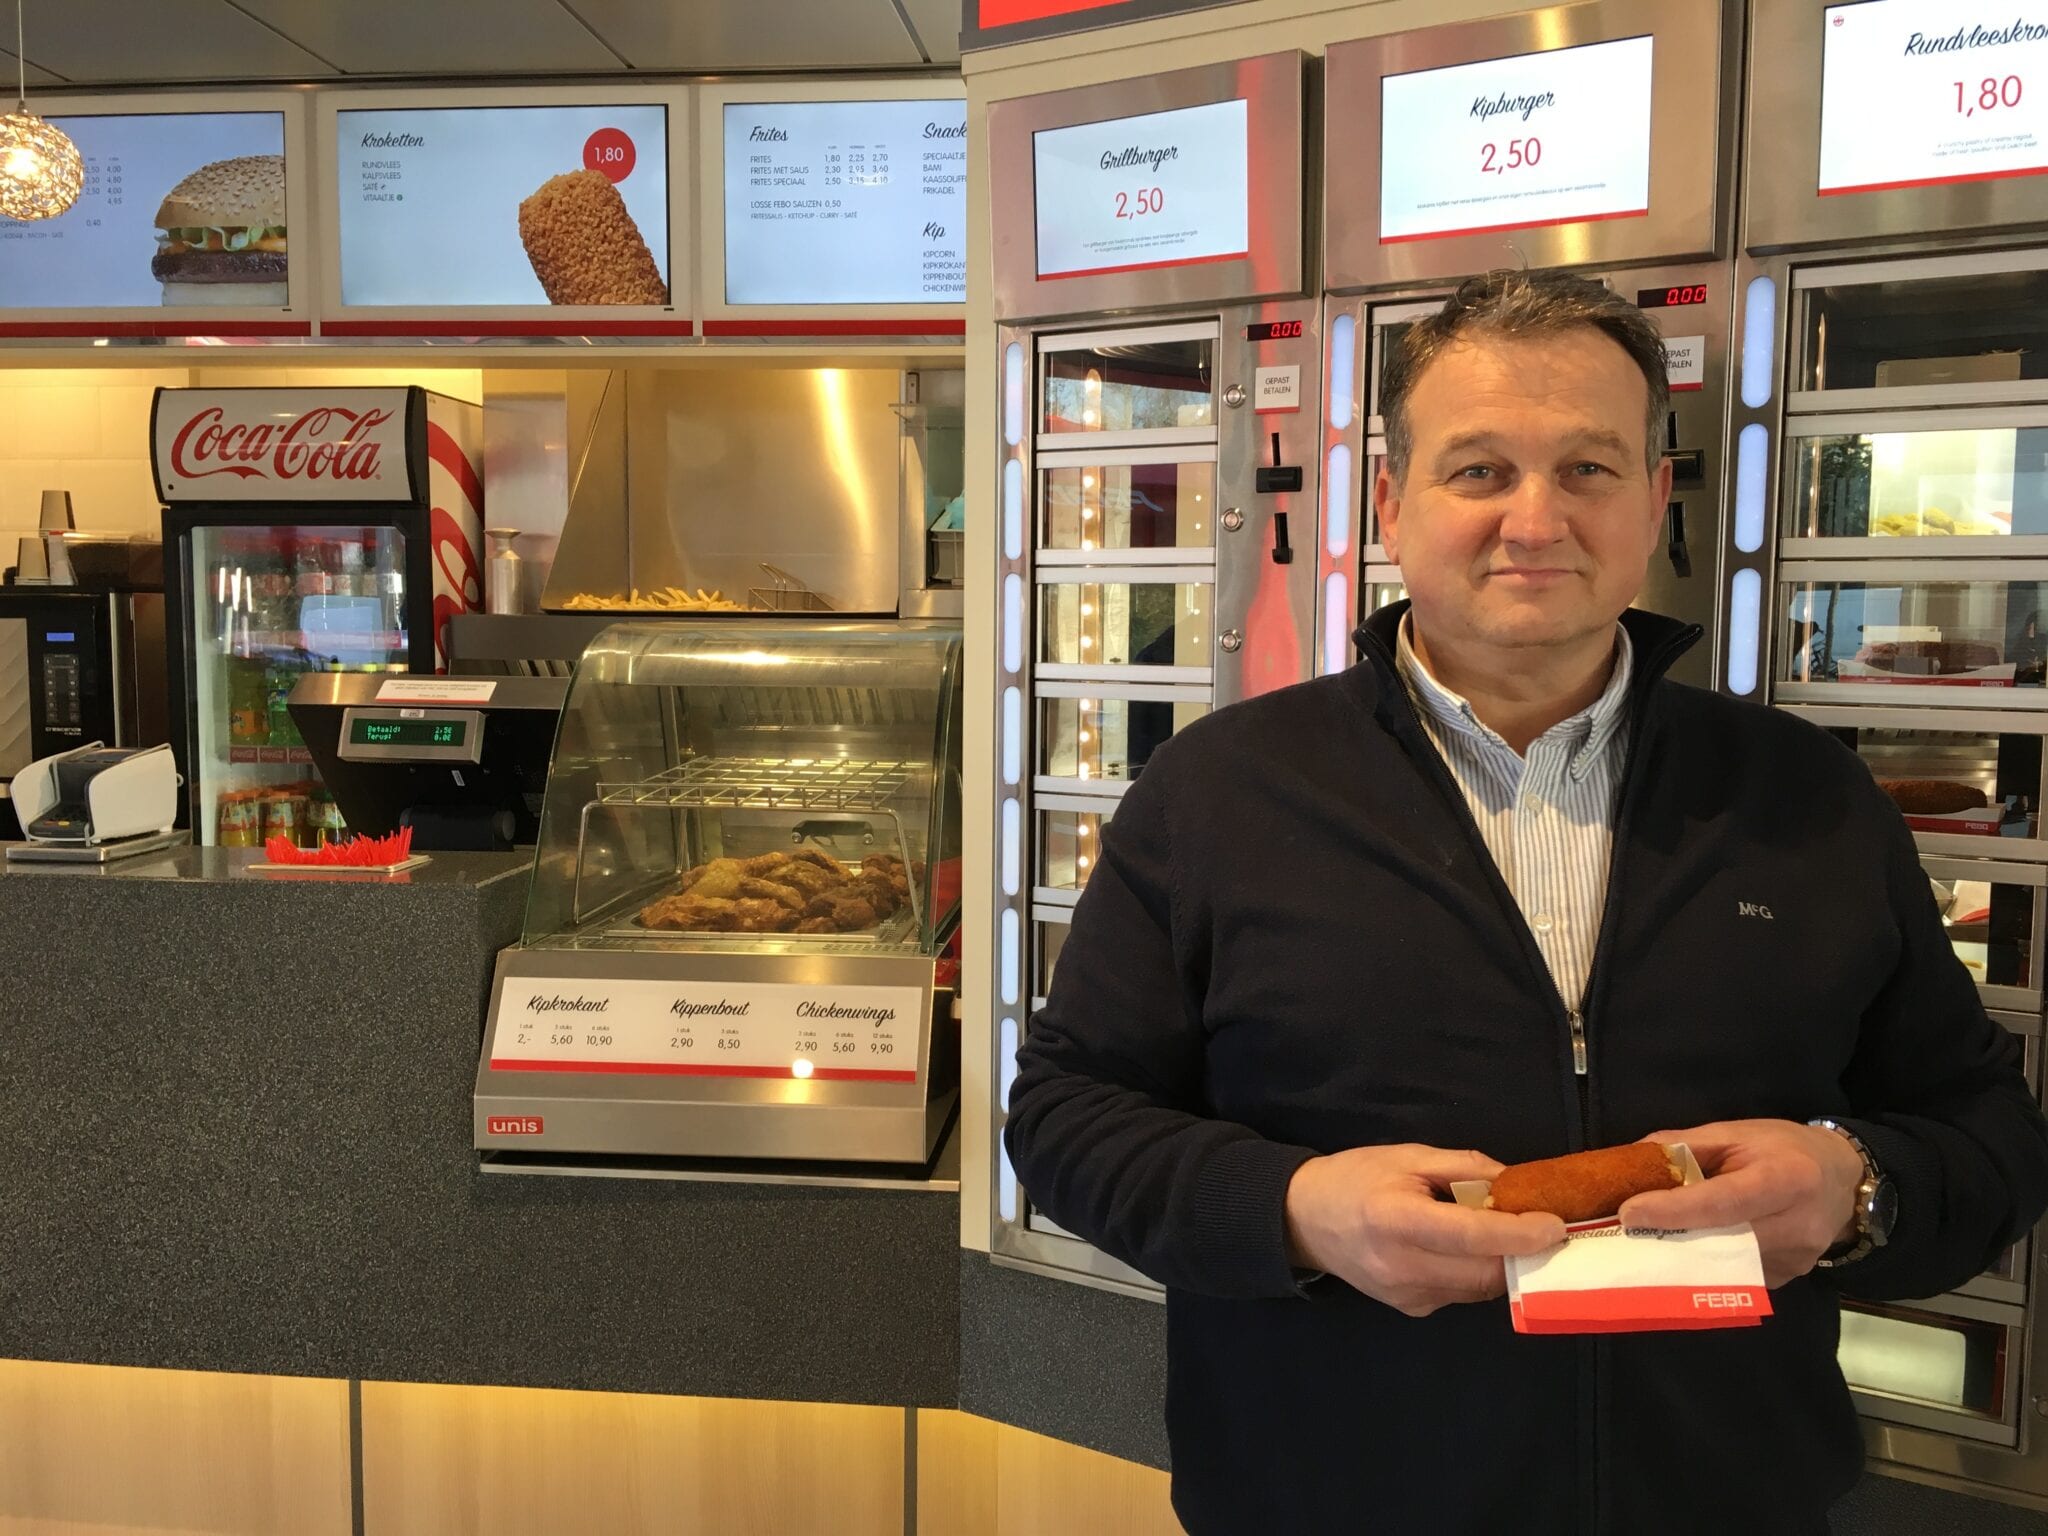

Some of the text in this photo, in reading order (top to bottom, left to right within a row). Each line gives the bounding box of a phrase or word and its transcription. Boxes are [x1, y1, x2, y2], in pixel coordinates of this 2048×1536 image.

[1904, 17, 2048, 57] Rundvleeskro
[1954, 75, 2022, 117] 1,80
[1470, 91, 1555, 122] Kipburger
[749, 125, 789, 142] Frites
[922, 121, 967, 139] Snack
[361, 131, 425, 148] Kroketten
[594, 147, 624, 164] 1,80
[750, 155, 772, 163] FRITES
[1100, 146, 1178, 172] Grillburger
[1481, 137, 1541, 175] 2,50
[361, 161, 401, 169] RUNDVLEES
[750, 167, 772, 175] FRITES
[773, 166, 789, 174] MET
[789, 166, 809, 174] SAUS
[923, 164, 942, 172] BAMI
[362, 171, 402, 180] KALFSVLEES
[750, 178, 772, 186] FRITES
[773, 177, 806, 186] SPECIAAL
[923, 187, 956, 195] FRIKADEL
[750, 200, 772, 209] LOSSE
[773, 200, 792, 209] FEBO
[792, 200, 822, 209] SAUZEN
[1115, 187, 1163, 220] 2,50
[788, 211, 815, 220] KETCHUP
[923, 222, 946, 241] Kip
[923, 250, 956, 258] KIPCORN
[1667, 286, 1707, 304] 0.00
[1270, 321, 1302, 337] 0.00
[1661, 349, 1691, 358] EPAST
[1265, 376, 1290, 385] GEPAST
[1263, 387, 1291, 395] BETALEN
[171, 407, 395, 480] Coca-Cola
[1965, 822, 1988, 830] FEBO
[526, 994, 609, 1015] Kipkrokant
[670, 998, 750, 1019] Kippenbout
[796, 1000, 896, 1028] Chickenwings
[518, 1033, 531, 1044] 2,-
[551, 1034, 573, 1045] 5,60
[586, 1035, 612, 1046] 10,90
[671, 1037, 693, 1049] 2,90
[718, 1038, 740, 1050] 8,50
[795, 1041, 817, 1053] 2,90
[832, 1042, 855, 1054] 5,60
[871, 1043, 893, 1055] 9,90
[492, 1118, 538, 1132] unis
[1563, 1226, 1622, 1244] peciaal
[1625, 1228, 1657, 1236] voor
[1692, 1293, 1753, 1308] FEBO
